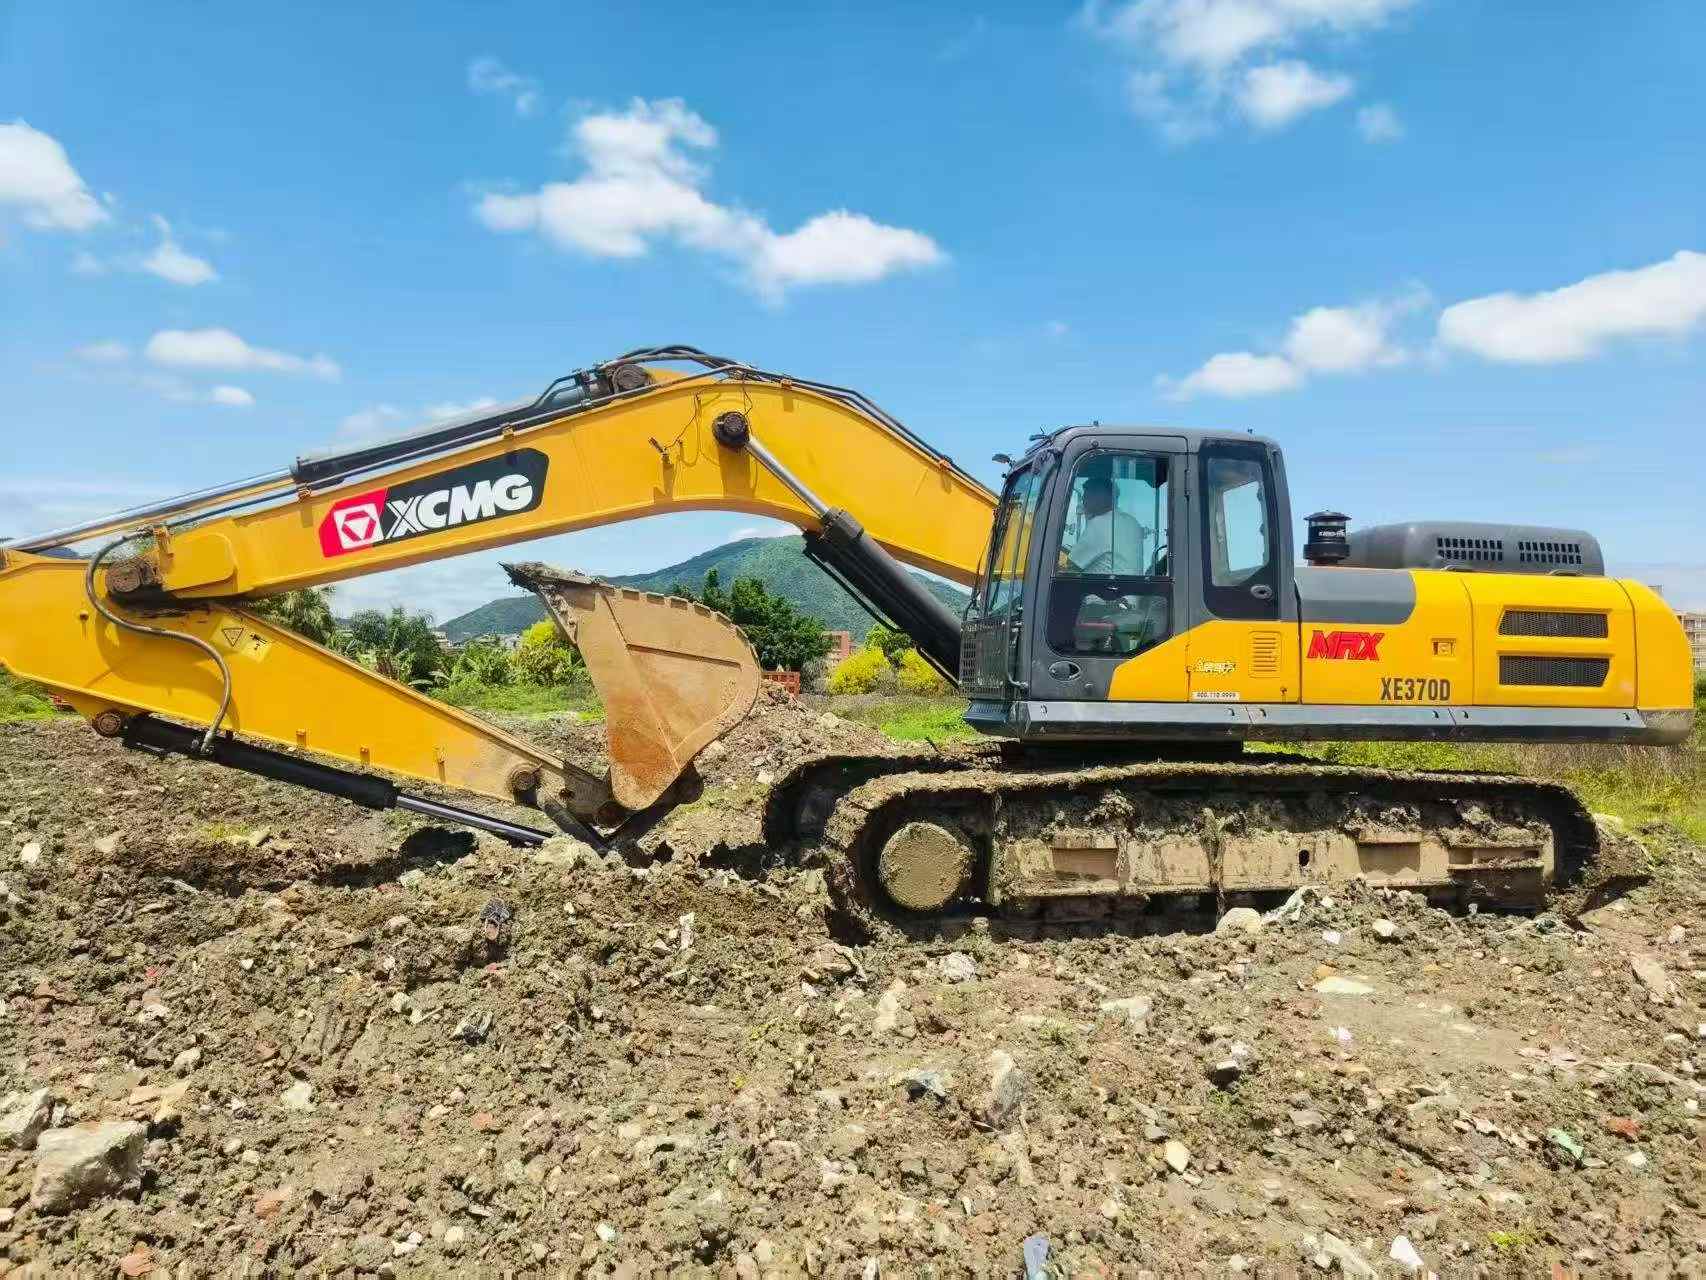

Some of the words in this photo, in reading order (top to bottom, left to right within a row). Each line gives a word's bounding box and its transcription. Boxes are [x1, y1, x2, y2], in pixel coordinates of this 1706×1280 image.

[386, 474, 533, 540] XCMG
[1307, 630, 1385, 661] MAX
[1380, 678, 1451, 701] XE370D
